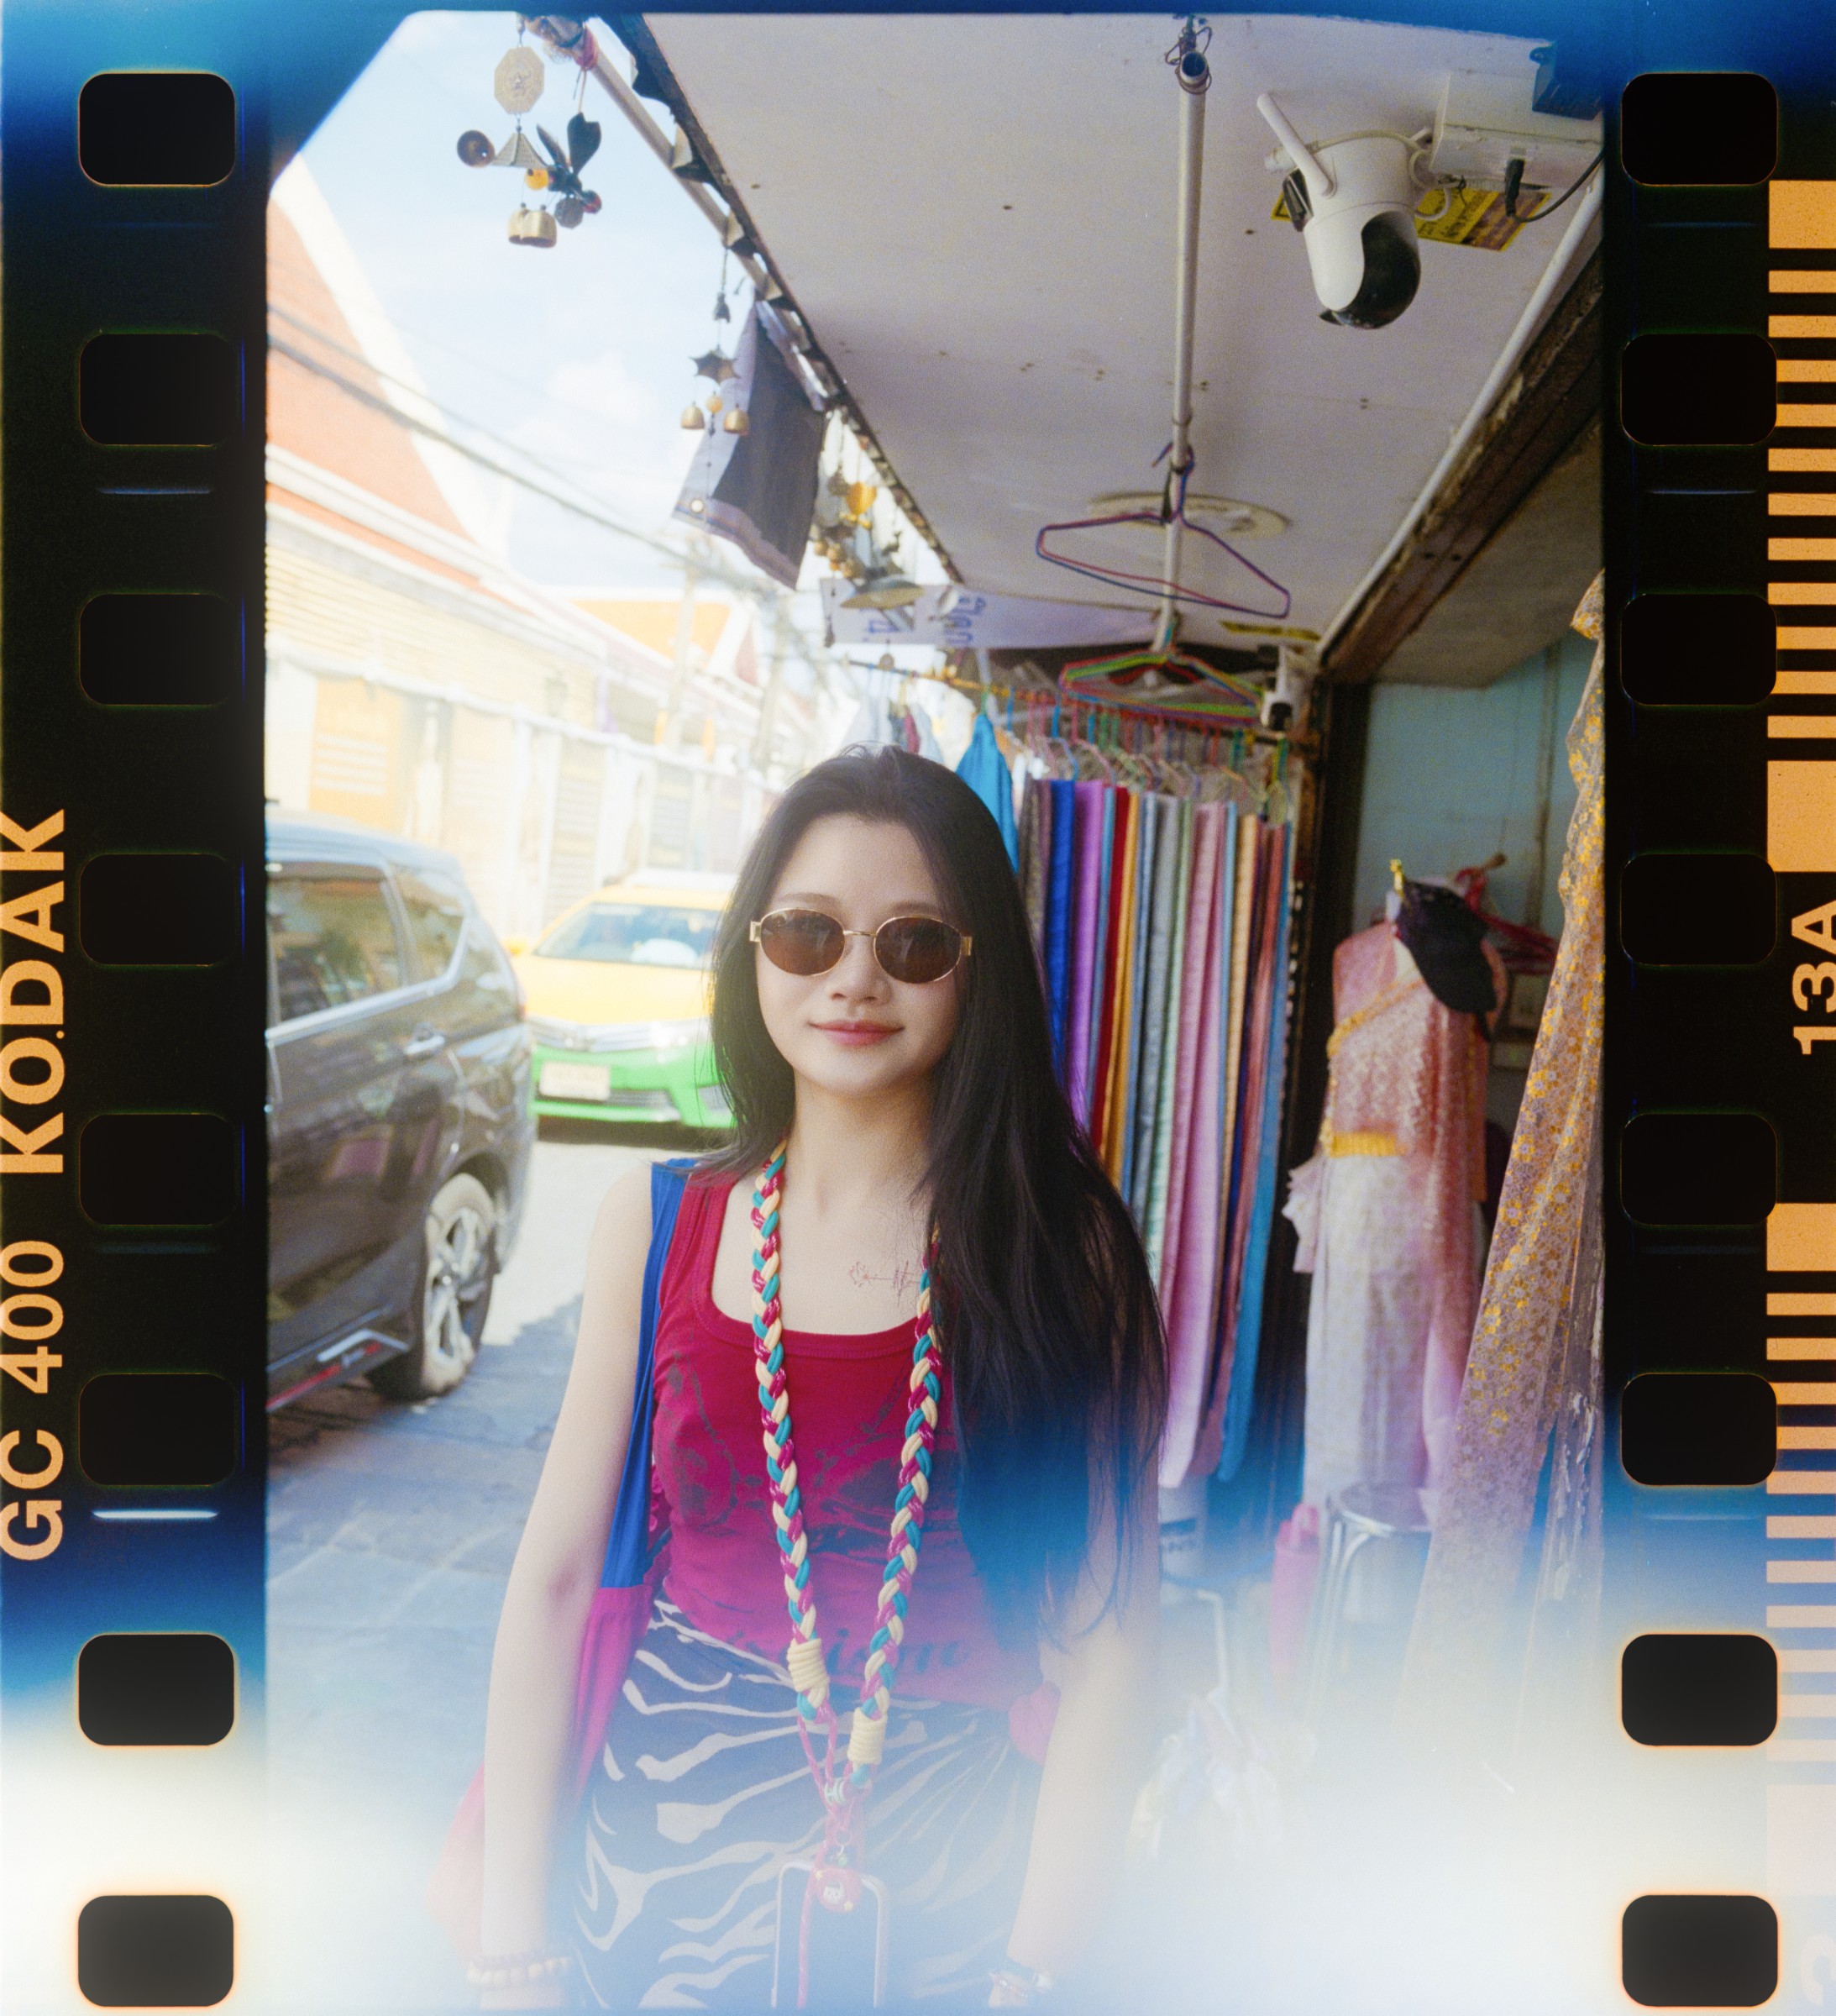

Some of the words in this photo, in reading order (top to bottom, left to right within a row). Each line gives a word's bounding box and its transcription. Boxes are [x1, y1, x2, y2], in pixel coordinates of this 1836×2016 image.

[1791, 900, 1836, 1055] 13A
[0, 1241, 63, 1394] 400
[0, 1430, 63, 1560] GC
